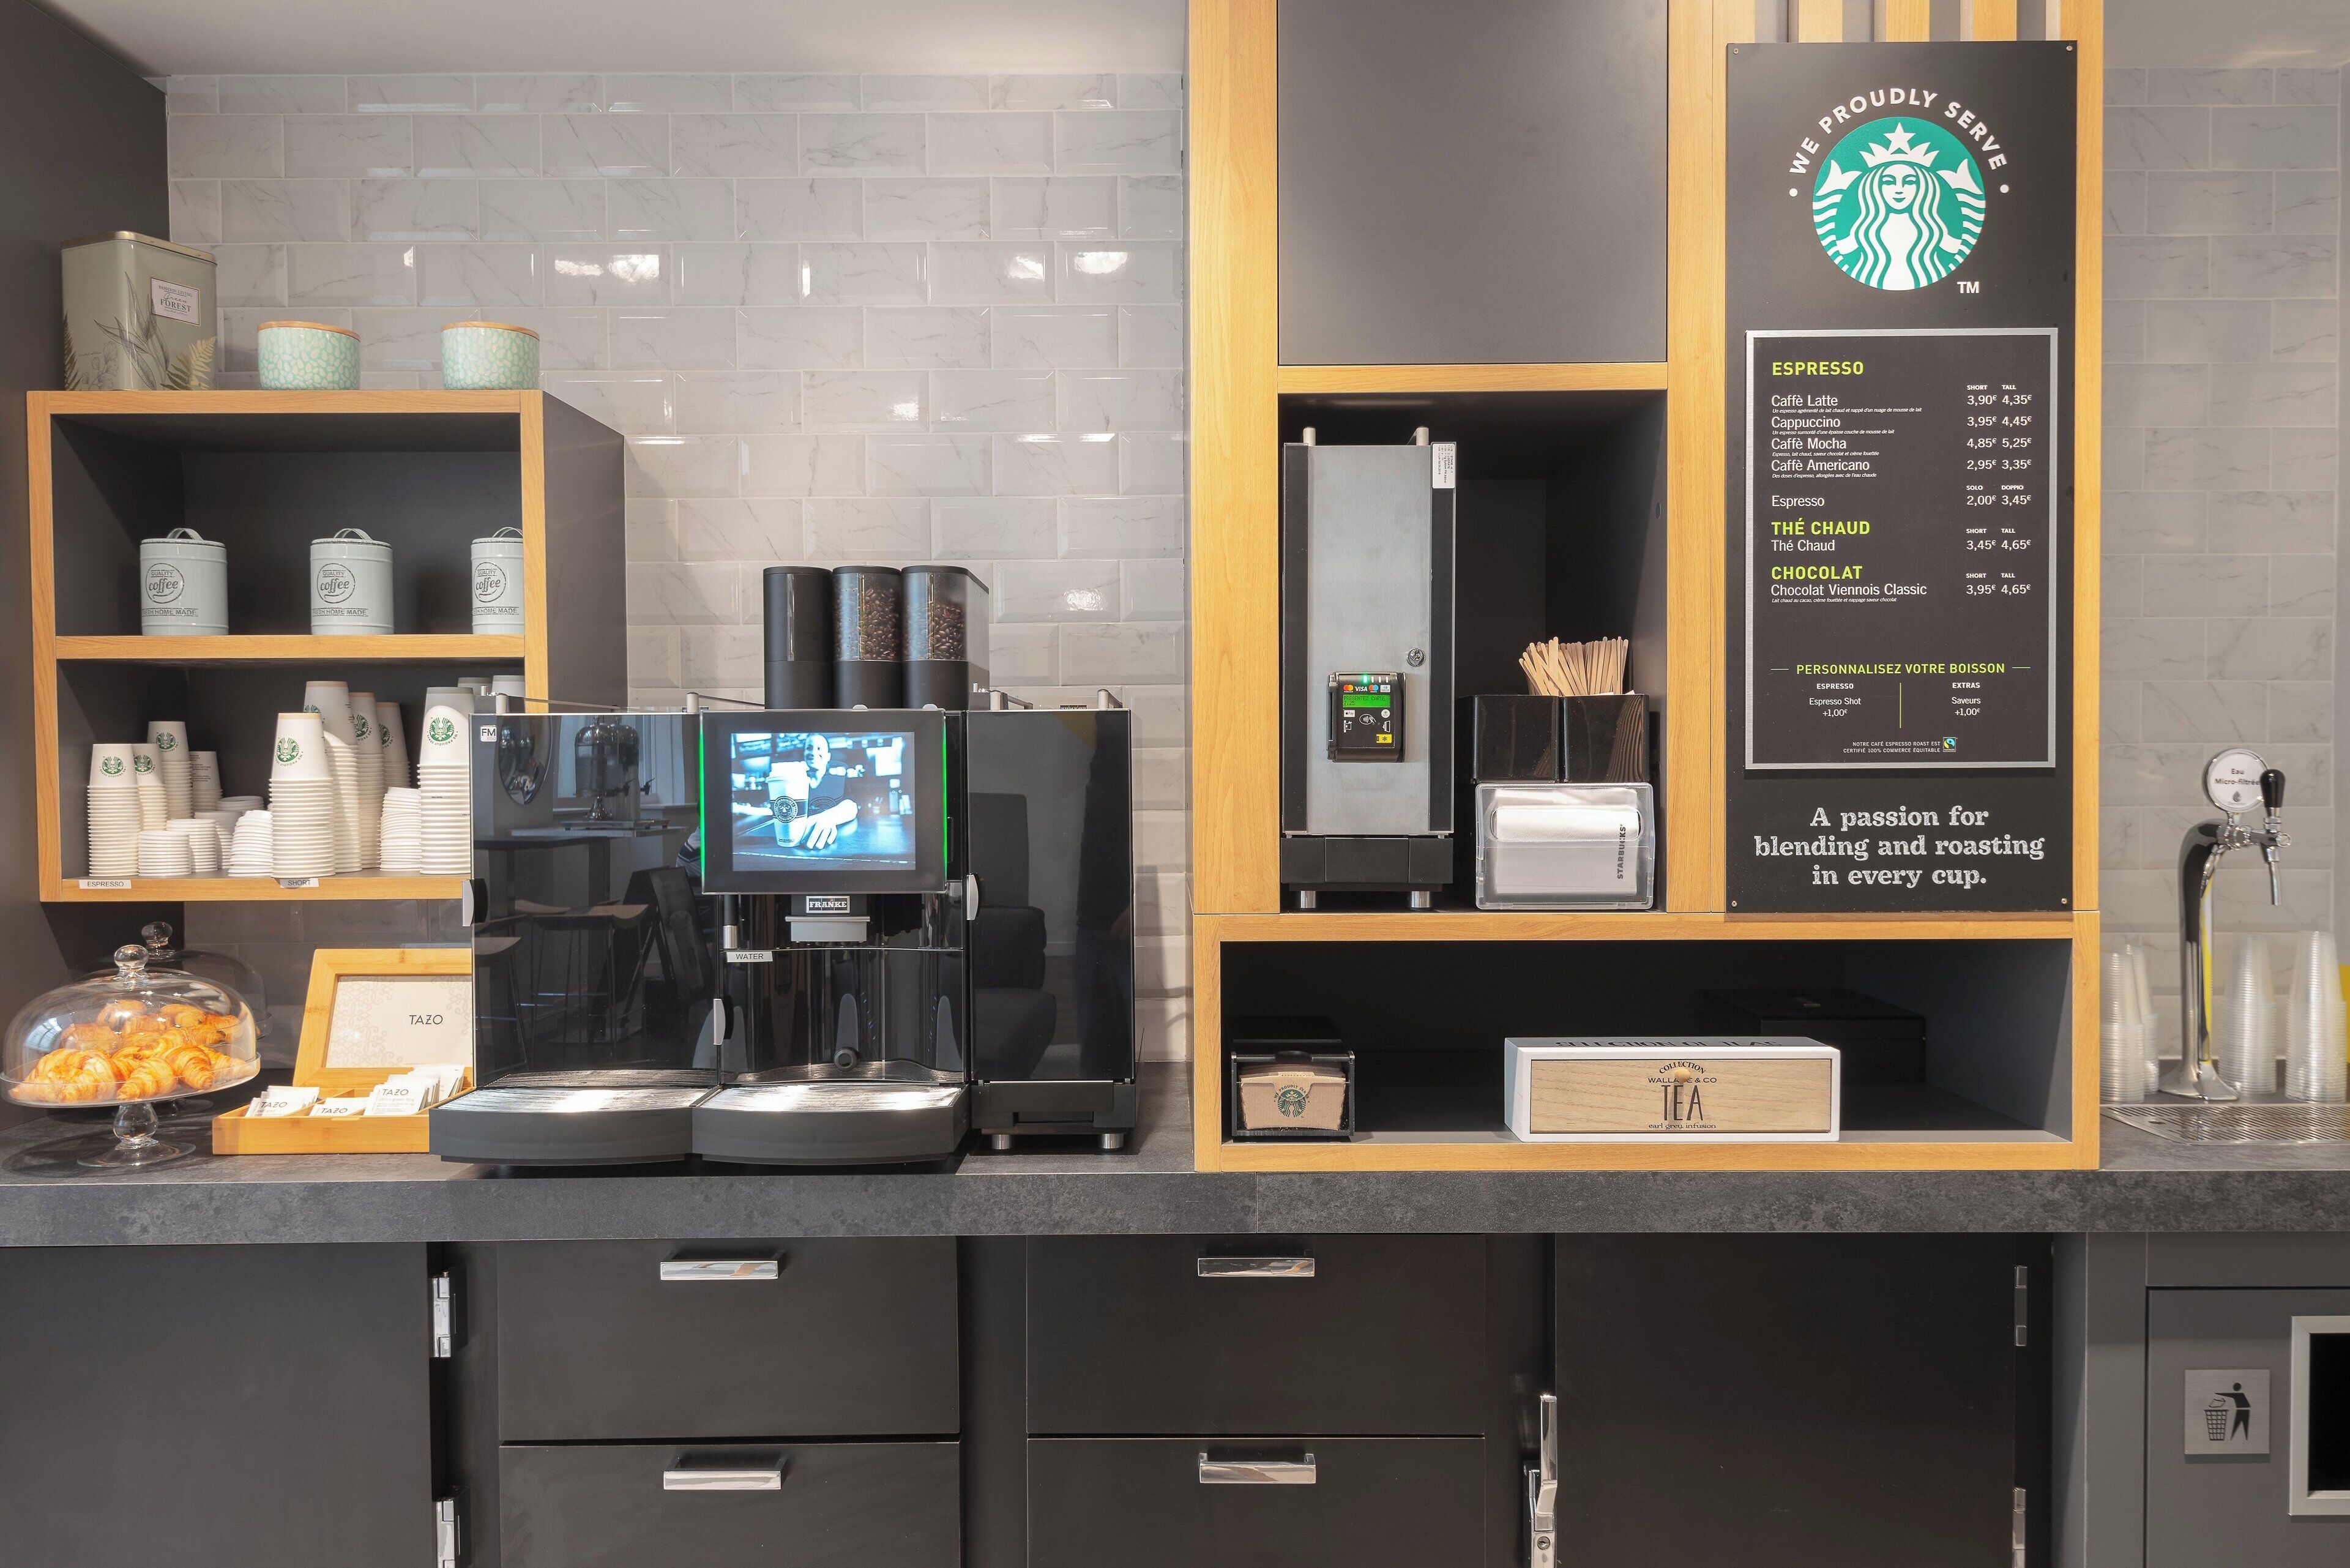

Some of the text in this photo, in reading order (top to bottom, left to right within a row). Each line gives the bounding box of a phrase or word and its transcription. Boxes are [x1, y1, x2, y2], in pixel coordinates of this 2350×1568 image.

[1789, 88, 2008, 176] WE PROUDLY SERVE
[1956, 281, 1980, 294] TM
[160, 299, 192, 312] FOREST
[1772, 361, 1863, 376] ESPRESSO
[1771, 394, 2032, 407] Caffè Latte 3,90€ 4,35€
[1771, 416, 2032, 430] Cappuccino 3,95€ 4,45€
[1771, 437, 2032, 450] Caffè Mocha 4,85€ 5,25€
[1771, 459, 2032, 471] Caffè Americano 2,95€ 3,35€
[1772, 495, 2032, 509] Espresso 2,00€ 3,45€
[1771, 518, 1870, 536] THÉ CHAUD
[1771, 539, 2032, 551] Thé Chaud 3,45€ 4,65€
[1771, 566, 1863, 580] CHOCOLAT
[149, 578, 178, 593] coffee
[320, 578, 349, 593] coffee
[476, 577, 501, 592] coffee
[1770, 583, 2031, 596] Chocolat Viennois Classic 3,95€ 4,65€
[1797, 663, 2005, 674] PERSONNALISEZ VOTRE BOISSON
[1809, 697, 1842, 707] Espresso
[1822, 709, 1848, 718] +1,00€
[1954, 707, 1980, 717] +1,00€
[1810, 805, 1989, 832] A passion for
[1617, 826, 1626, 879] STARBUCKS
[1753, 834, 2045, 861] blending and roasting
[1812, 864, 1986, 889] in every cup.
[409, 1015, 443, 1025] TAZO
[1659, 1061, 1706, 1074] COLLECTION
[1661, 1085, 1703, 1121] TEA
